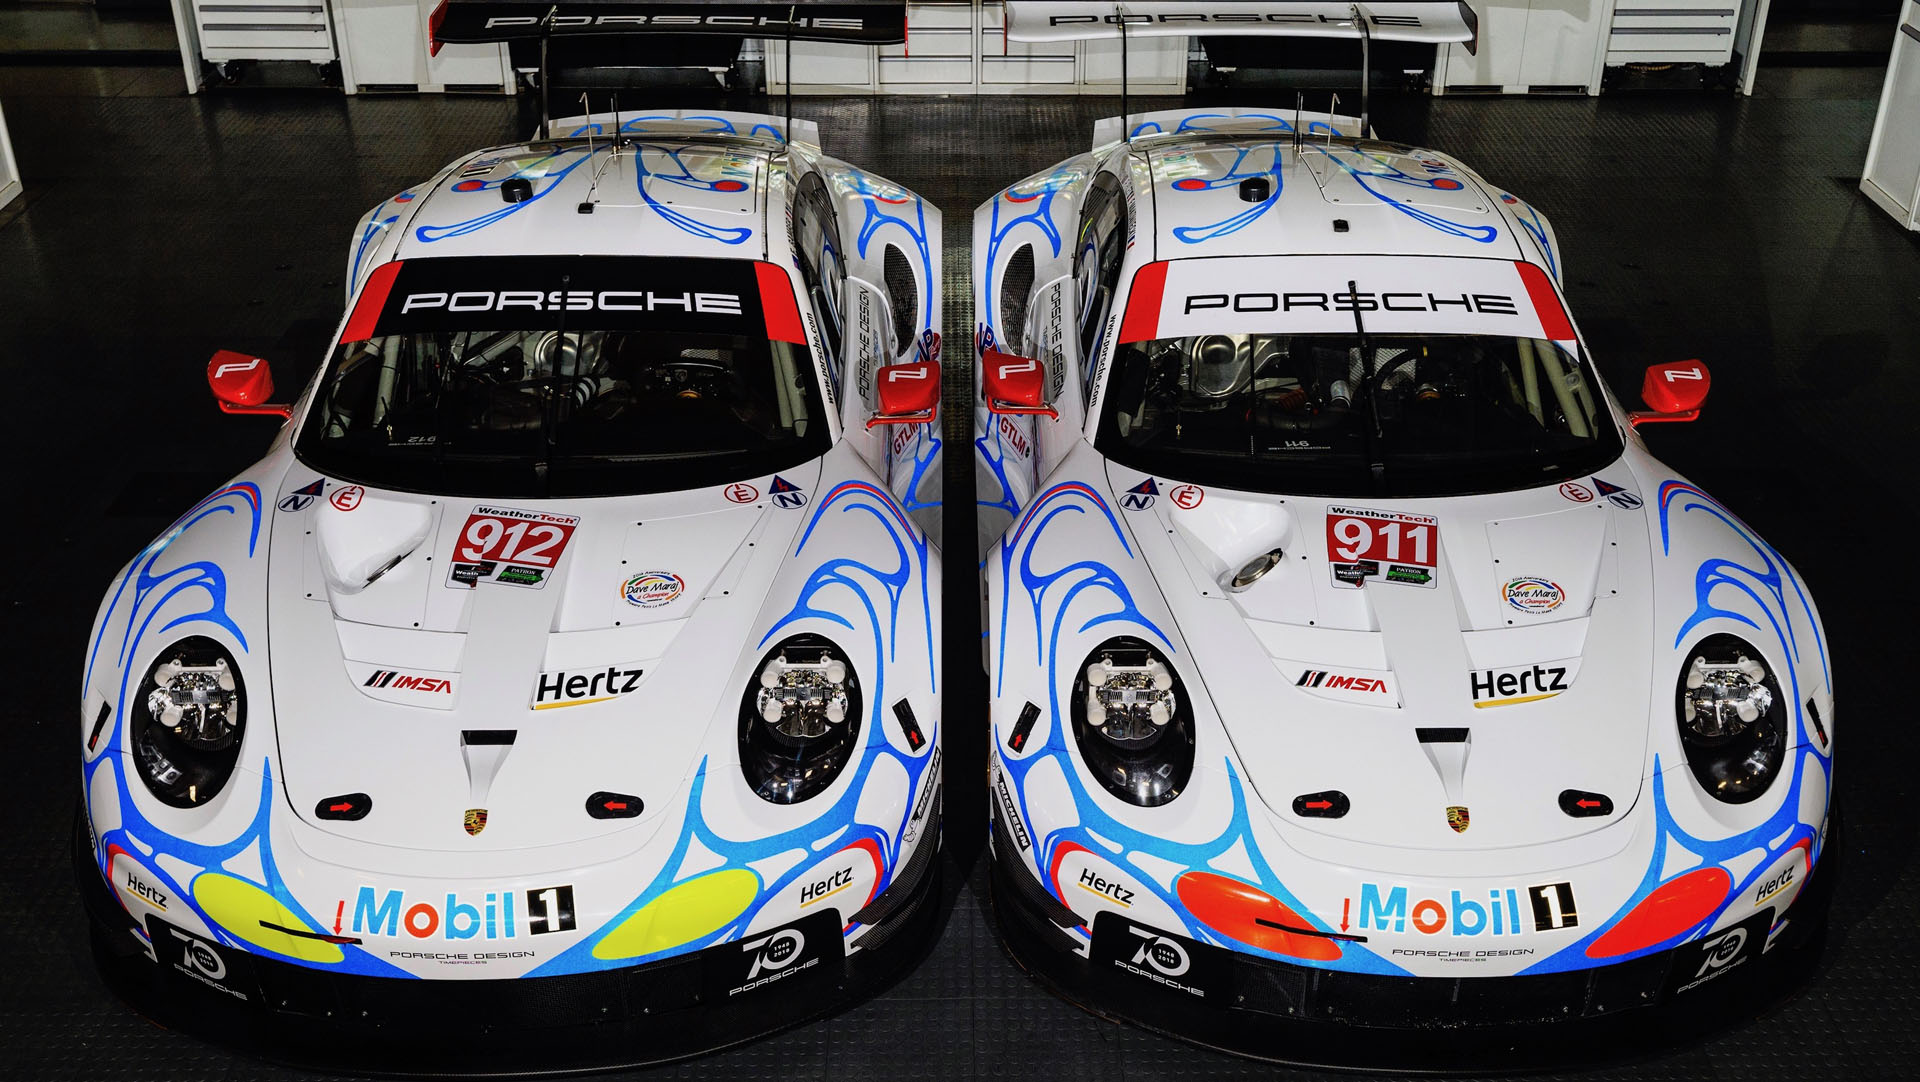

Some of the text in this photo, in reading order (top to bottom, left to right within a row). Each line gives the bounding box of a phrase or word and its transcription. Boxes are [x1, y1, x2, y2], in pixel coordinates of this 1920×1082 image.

[484, 16, 863, 30] PORSCHE
[1050, 14, 1422, 26] PORSCHE
[401, 291, 742, 315] PORSCHE
[1184, 292, 1518, 315] PORSCHE
[806, 312, 834, 404] www.porsche.com
[859, 286, 870, 400] PORSCHE DESIGN
[1051, 283, 1065, 398] PORSCHE DESIGN
[1091, 314, 1117, 408] www.porsche.com
[894, 422, 919, 454] GTLM
[1001, 417, 1025, 456] GTLM
[478, 507, 575, 524] WeatherTech
[1332, 507, 1433, 524] WeatherTech
[462, 518, 564, 565] 912
[1333, 518, 1428, 563] 911
[626, 582, 679, 594] Dave Maraj
[1531, 589, 1559, 600] Maraj
[392, 676, 451, 694] IMSA
[537, 667, 643, 702] Hertz
[1325, 675, 1387, 694] IMSA
[1471, 665, 1568, 700] Hertz
[998, 782, 1029, 847] MICHELIN
[128, 872, 167, 908] Hertz
[801, 866, 852, 903] Hertz
[1080, 868, 1134, 904] Hertz
[1756, 865, 1794, 902] Hertz
[352, 886, 516, 940] Mobil
[1359, 883, 1521, 936] Mobil
[390, 951, 535, 960] PORSCHE DESIGN
[743, 929, 805, 980] 70
[1129, 925, 1190, 976] 70
[1392, 948, 1534, 957] PORSCHE DESIGN
[1695, 927, 1747, 978] 70
[174, 963, 247, 1000] PORSCHE
[729, 957, 819, 996] PORSCHE
[1115, 960, 1204, 997] PORSCHE
[1677, 955, 1748, 994] PORSCHE
